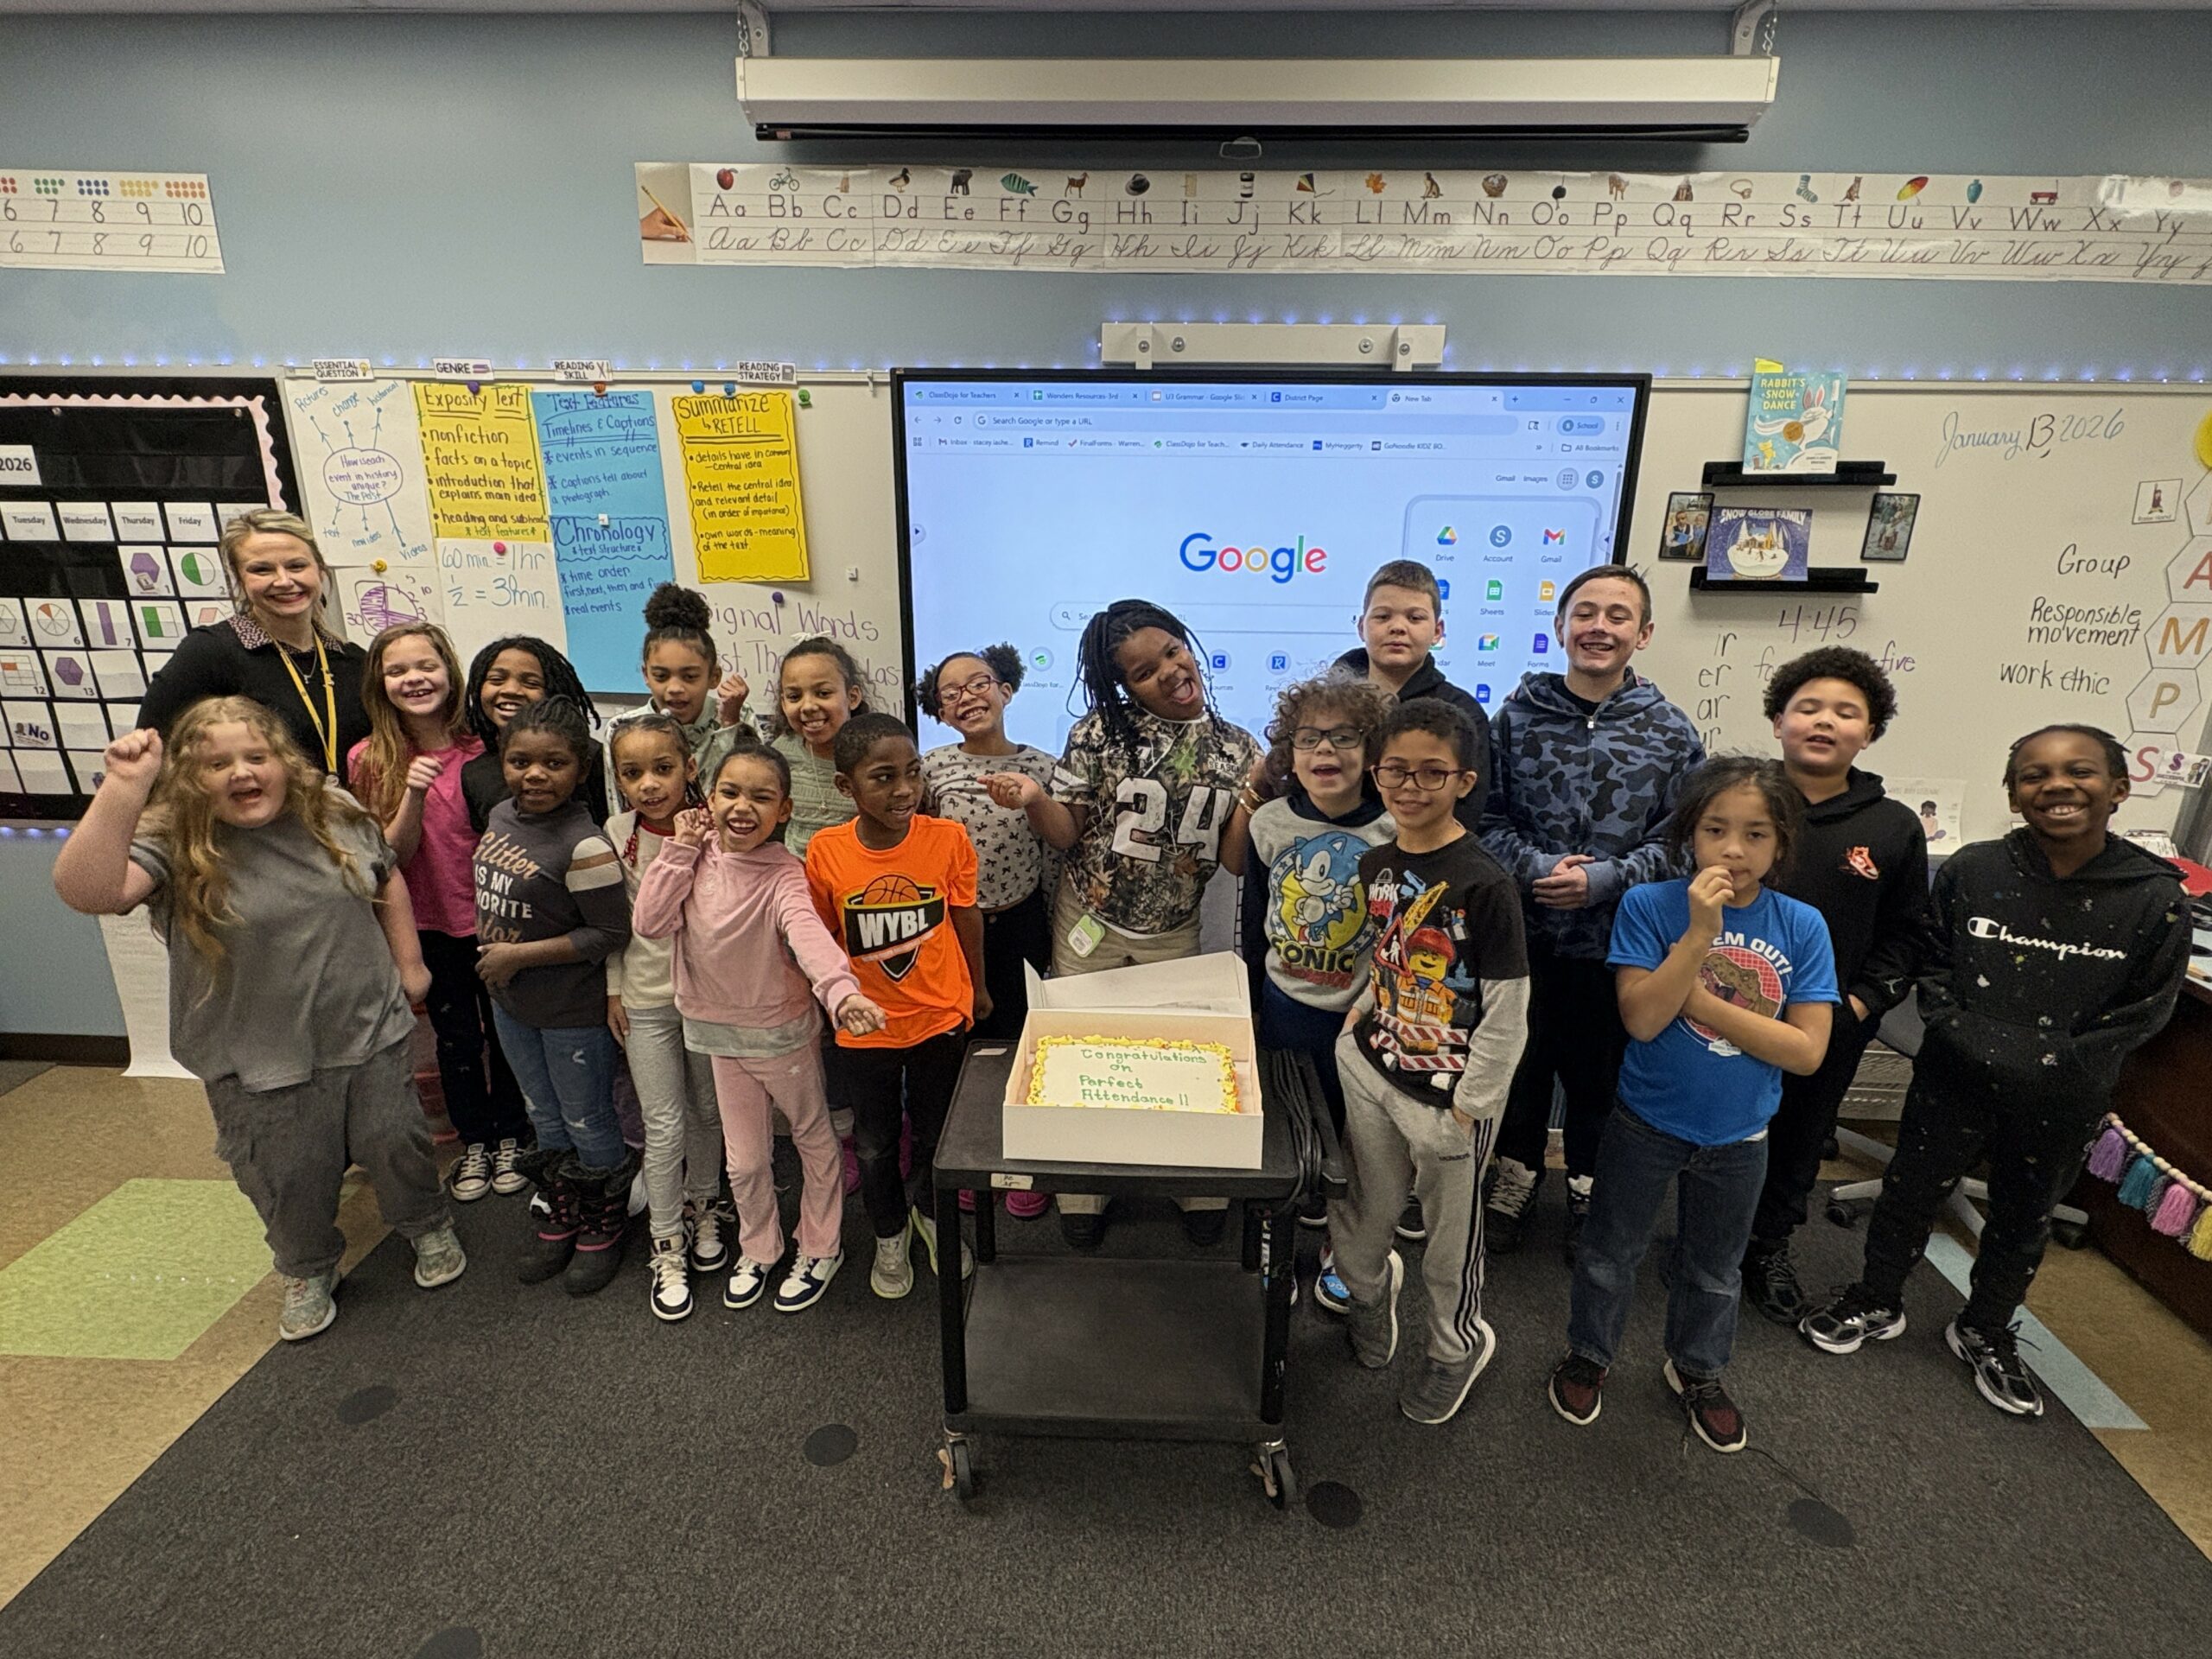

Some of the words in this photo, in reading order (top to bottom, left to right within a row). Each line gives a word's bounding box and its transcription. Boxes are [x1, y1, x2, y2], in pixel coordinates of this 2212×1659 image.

[4, 199, 16, 221] 6
[47, 200, 58, 221] 7
[92, 200, 105, 223] 8
[137, 202, 152, 225] 9
[181, 202, 203, 226] 10
[10, 230, 23, 253] 6
[48, 231, 60, 254] 7
[93, 232, 110, 255] 8
[139, 234, 153, 256] 9
[186, 235, 207, 257] 10
[314, 361, 358, 370] ESSENTIAL
[316, 369, 359, 378] QUESTION
[436, 363, 470, 373] GENRE
[555, 361, 594, 371] READING
[564, 371, 588, 380] SKILL
[739, 362, 780, 372] READING
[739, 372, 781, 381] STRATEGY
[1761, 378, 1806, 388] RABBIT'S
[493, 387, 524, 407] Text
[1308, 394, 1324, 403] Page
[1765, 390, 1796, 399] SNOW
[677, 395, 771, 419] Summarize
[1763, 401, 1797, 410] DANCE
[542, 420, 594, 439] Timelines
[607, 415, 655, 432] Captions
[713, 416, 761, 435] RETELL
[993, 416, 1017, 425] Search
[1018, 416, 1044, 427] Google
[1054, 418, 1071, 427] type
[429, 423, 509, 444] nonfiction
[1935, 411, 2023, 469] January
[2058, 408, 2125, 442] 2026
[434, 447, 468, 466] facts
[474, 456, 487, 467] on
[491, 458, 499, 467] a
[501, 452, 532, 473] topic
[556, 448, 593, 463] events
[595, 447, 606, 456] in
[610, 443, 658, 456] sequence
[0, 457, 32, 471] 2026
[435, 473, 505, 488] introduction
[511, 475, 534, 490] that
[697, 480, 723, 493] Retell
[727, 482, 741, 492] the
[743, 479, 772, 490] central
[775, 478, 792, 488] idea
[439, 490, 482, 502] explains
[515, 492, 537, 503] idea
[12, 515, 45, 526] Tuesday
[63, 516, 107, 526] Wednesday
[122, 516, 155, 526] Thursday
[178, 517, 201, 526] Friday
[1719, 508, 1747, 524] SNOW
[1776, 511, 1807, 525] FAMILY
[556, 518, 655, 547] Chronology
[442, 545, 462, 569] 60
[467, 553, 489, 568] min
[1179, 532, 1327, 584] Google
[1541, 555, 1562, 563] Gmail
[2057, 543, 2131, 579] Group
[569, 569, 594, 583] time
[598, 566, 631, 579] order
[165, 584, 171, 594] 1
[219, 586, 226, 594] 2
[798, 601, 879, 642] Words
[1480, 607, 1504, 616] Sheets
[2031, 596, 2141, 630] Responsible
[1778, 605, 1858, 644] 4:45
[22, 635, 28, 645] 5
[73, 636, 81, 645] 6
[125, 638, 132, 646] 7
[2027, 624, 2141, 646] movement
[2158, 616, 2210, 656] M
[1698, 664, 1732, 688] er
[2000, 659, 2053, 690] work
[2061, 665, 2110, 695] ethic
[34, 686, 46, 695] 12
[83, 687, 95, 696] 13
[2149, 682, 2181, 719] P
[1697, 695, 1730, 721] ar
[28, 723, 49, 741] No
[2129, 746, 2159, 782] S
[2169, 753, 2184, 771] S
[1111, 777, 1232, 862] 24
[491, 871, 513, 896] MY
[1369, 883, 1400, 905] WORK
[857, 908, 929, 949] WYBL
[1967, 917, 2127, 961] Champion
[1269, 934, 1357, 974] SONIC
[1750, 938, 1794, 976] OUT!
[1109, 1064, 1133, 1073] on
[1082, 1089, 1173, 1105] Attendance
